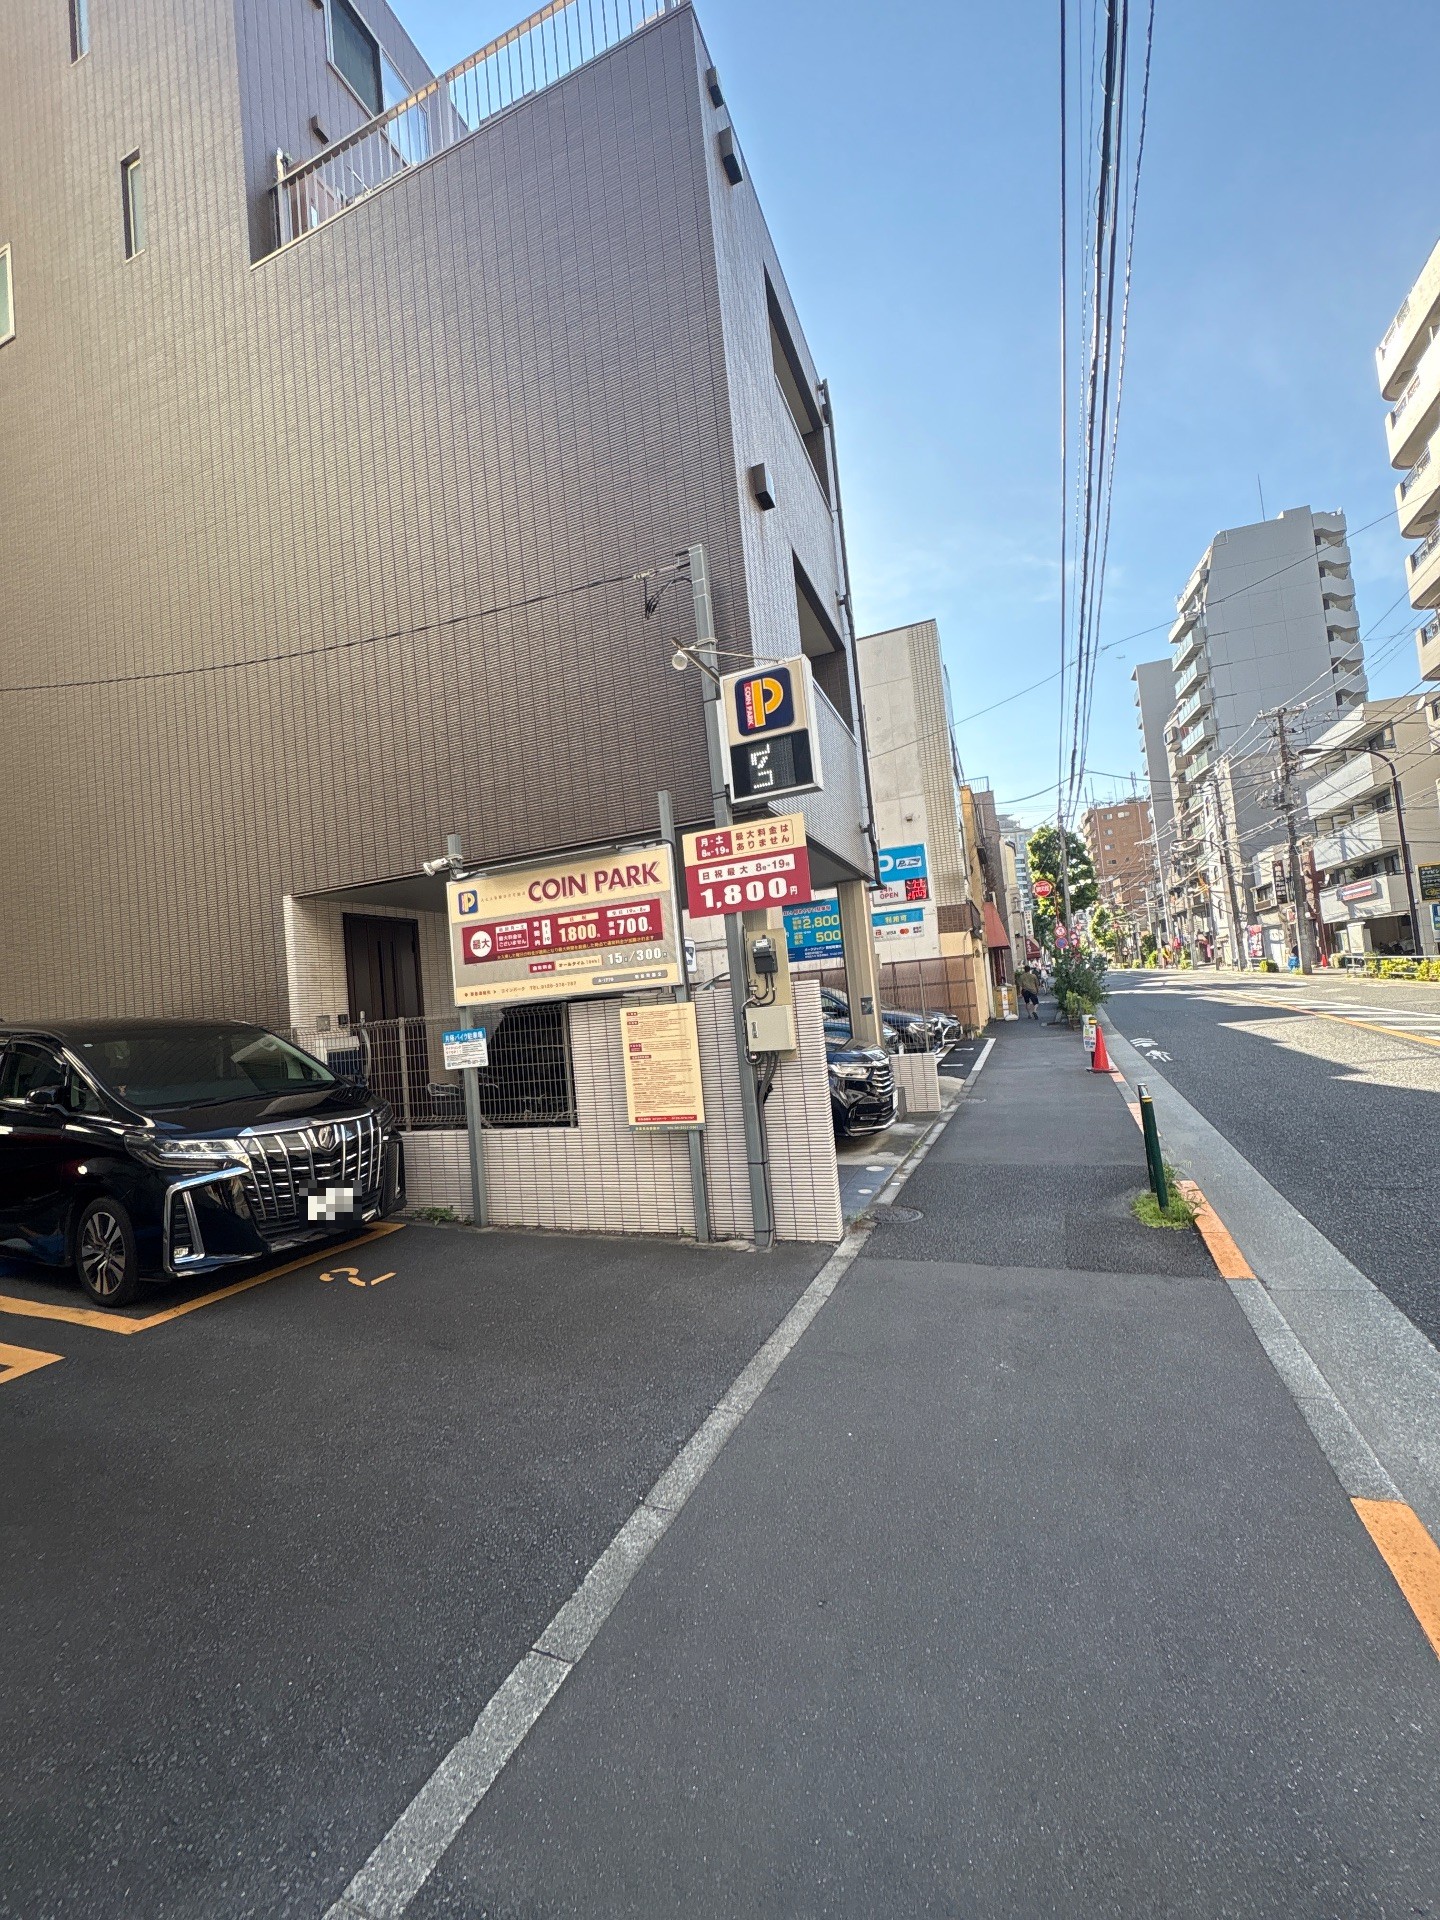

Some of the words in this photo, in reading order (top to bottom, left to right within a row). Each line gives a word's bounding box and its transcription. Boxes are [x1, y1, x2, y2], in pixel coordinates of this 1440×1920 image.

[746, 706, 754, 726] PARK
[736, 824, 788, 840] 最大料金は
[736, 835, 790, 851] ありません
[702, 865, 748, 880] 日祝最大
[528, 874, 587, 902] COIN
[594, 861, 661, 892] PARK
[700, 877, 798, 908] 1,800円
[803, 914, 840, 929] 2,800
[472, 938, 490, 950] 最大
